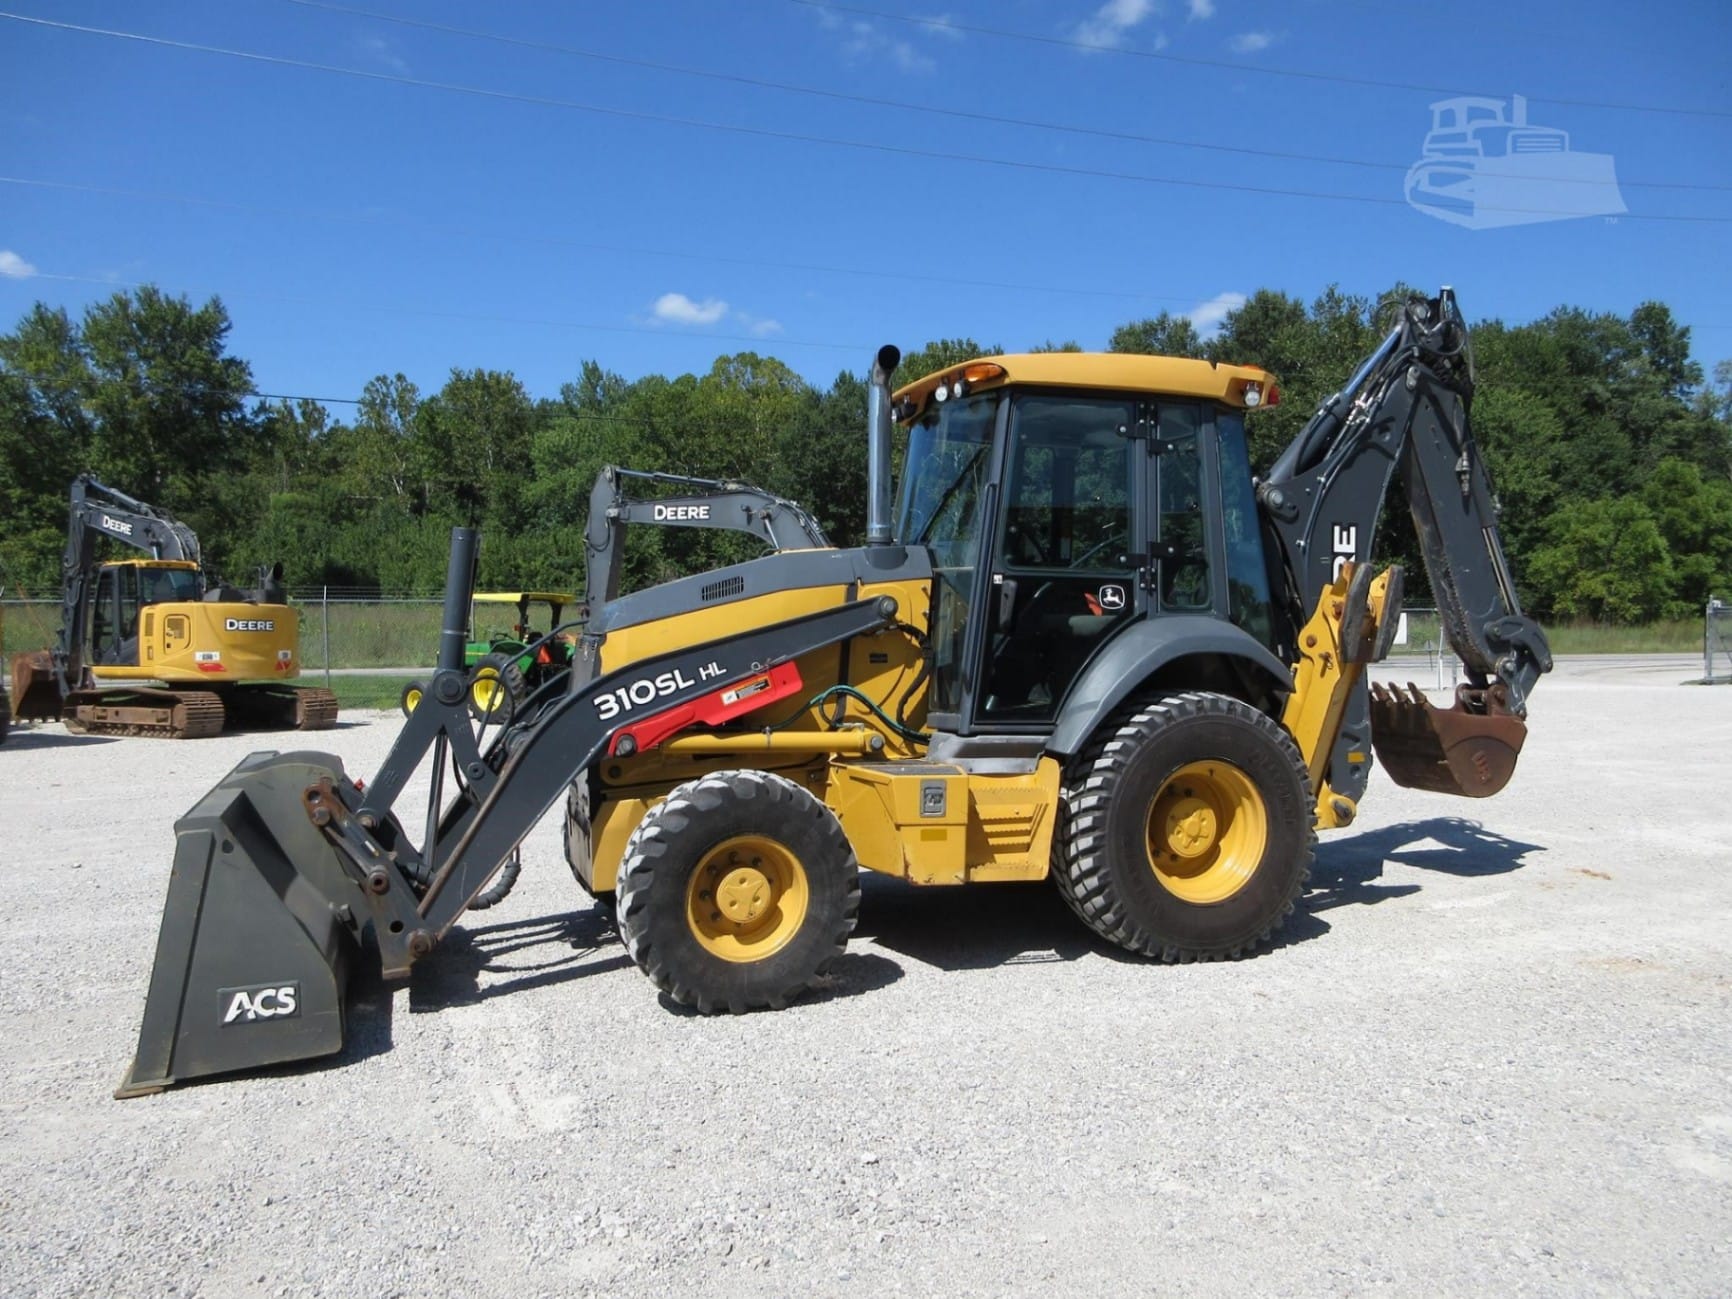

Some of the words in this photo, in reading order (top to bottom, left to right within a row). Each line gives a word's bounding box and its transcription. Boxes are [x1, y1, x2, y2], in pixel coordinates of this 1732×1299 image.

[653, 505, 710, 520] DEERE
[103, 514, 132, 535] DEERE
[226, 618, 274, 631] DEERE
[593, 669, 695, 720] 310SL
[699, 661, 727, 681] HL
[223, 986, 296, 1022] ACS
